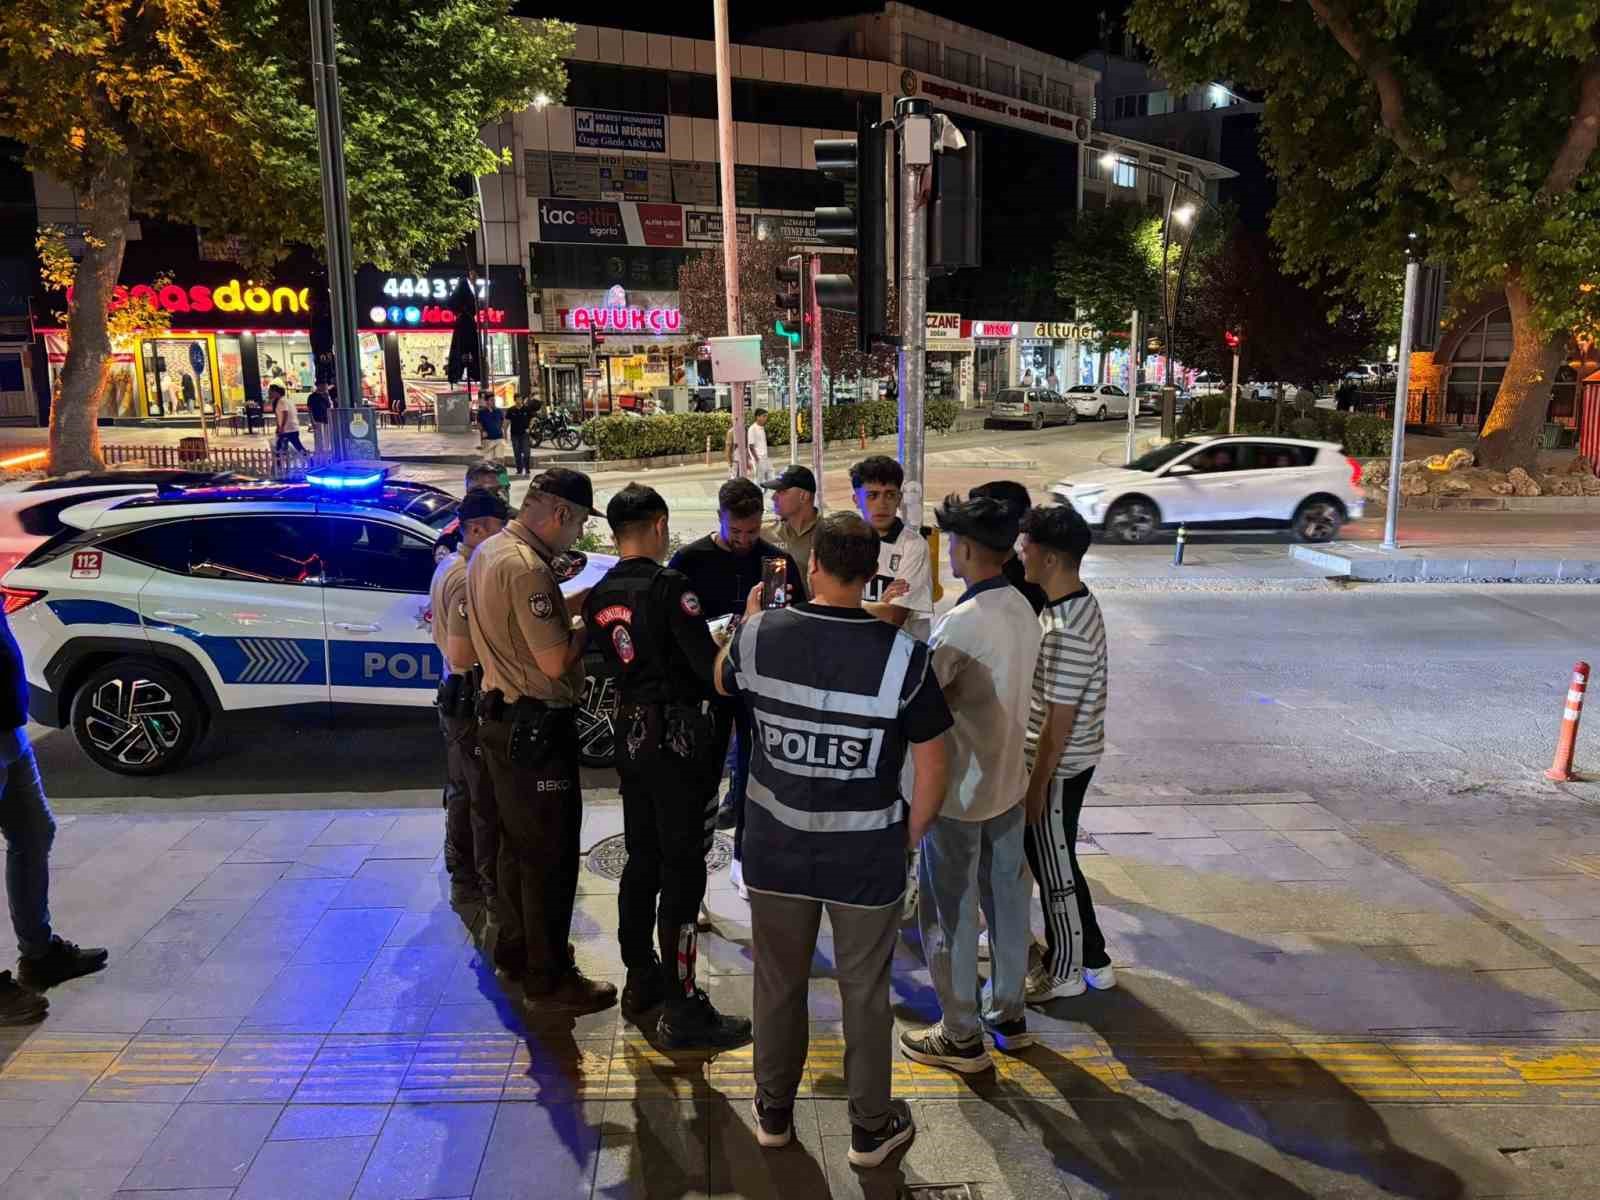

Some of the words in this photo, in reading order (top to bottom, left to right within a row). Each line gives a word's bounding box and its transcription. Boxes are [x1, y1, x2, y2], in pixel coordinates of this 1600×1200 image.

[926, 315, 959, 329] CZANE
[77, 553, 99, 569] 112
[364, 652, 440, 680] POL
